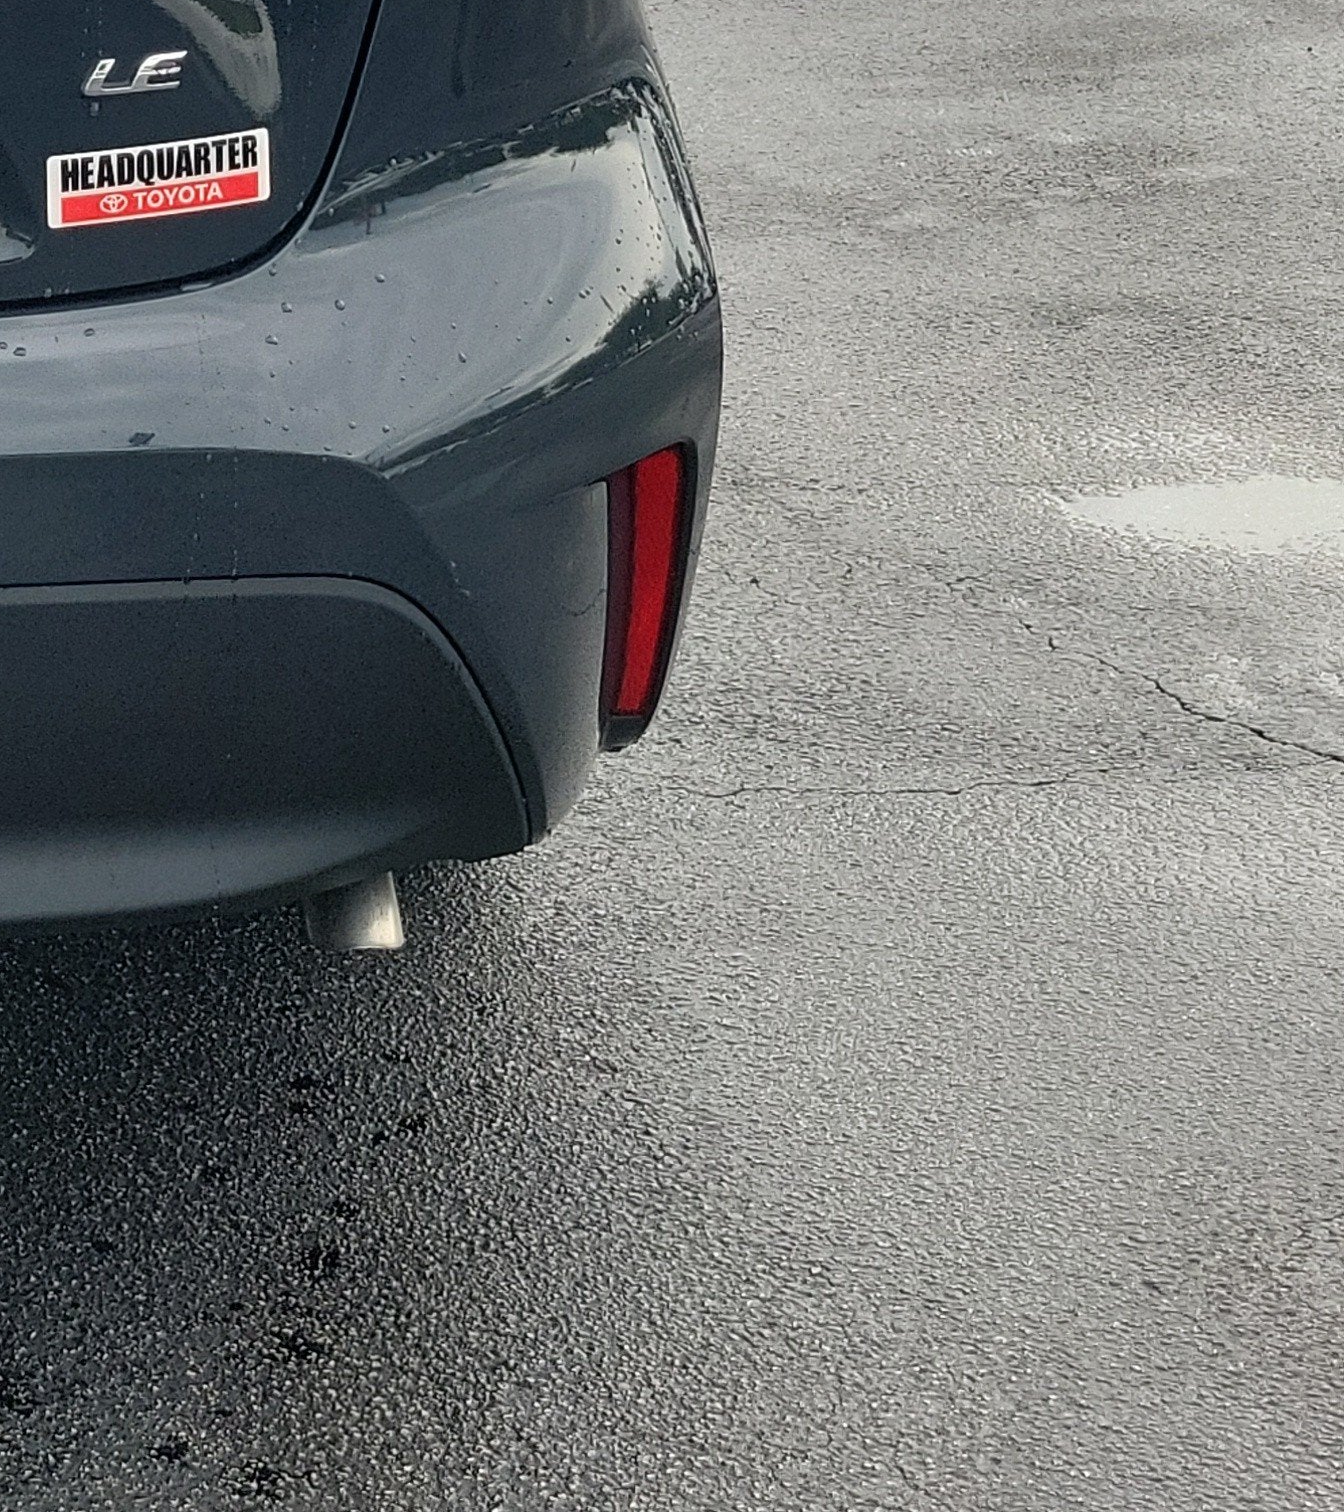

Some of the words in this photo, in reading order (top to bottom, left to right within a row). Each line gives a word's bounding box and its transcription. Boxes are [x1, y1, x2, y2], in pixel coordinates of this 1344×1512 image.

[81, 49, 188, 97] LE
[61, 134, 258, 194] HEADQUARTER
[133, 182, 223, 211] TOYOTA
